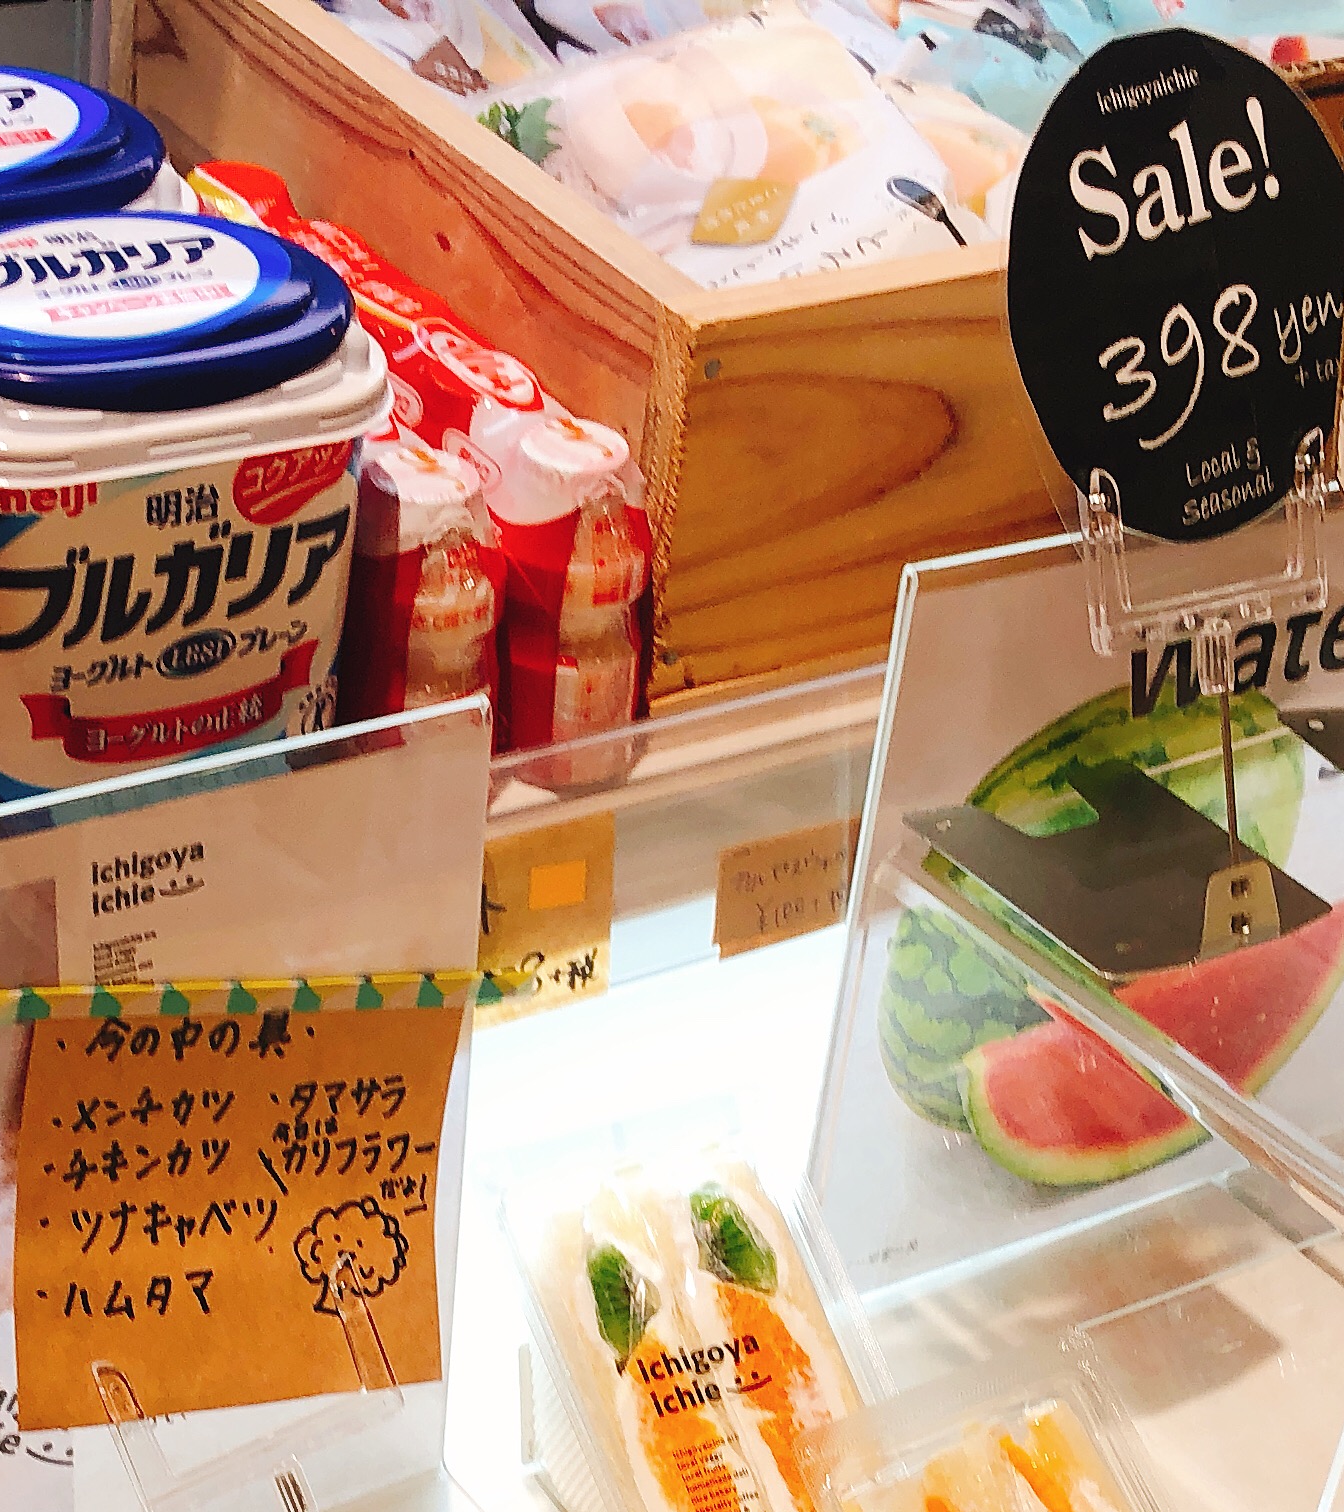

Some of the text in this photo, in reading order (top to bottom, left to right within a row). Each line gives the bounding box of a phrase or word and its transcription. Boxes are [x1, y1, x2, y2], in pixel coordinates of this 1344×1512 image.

[1068, 96, 1280, 262] Sale!
[1098, 283, 1260, 450] 398
[145, 483, 220, 529] 明治
[50, 652, 153, 693] ヨーグルト
